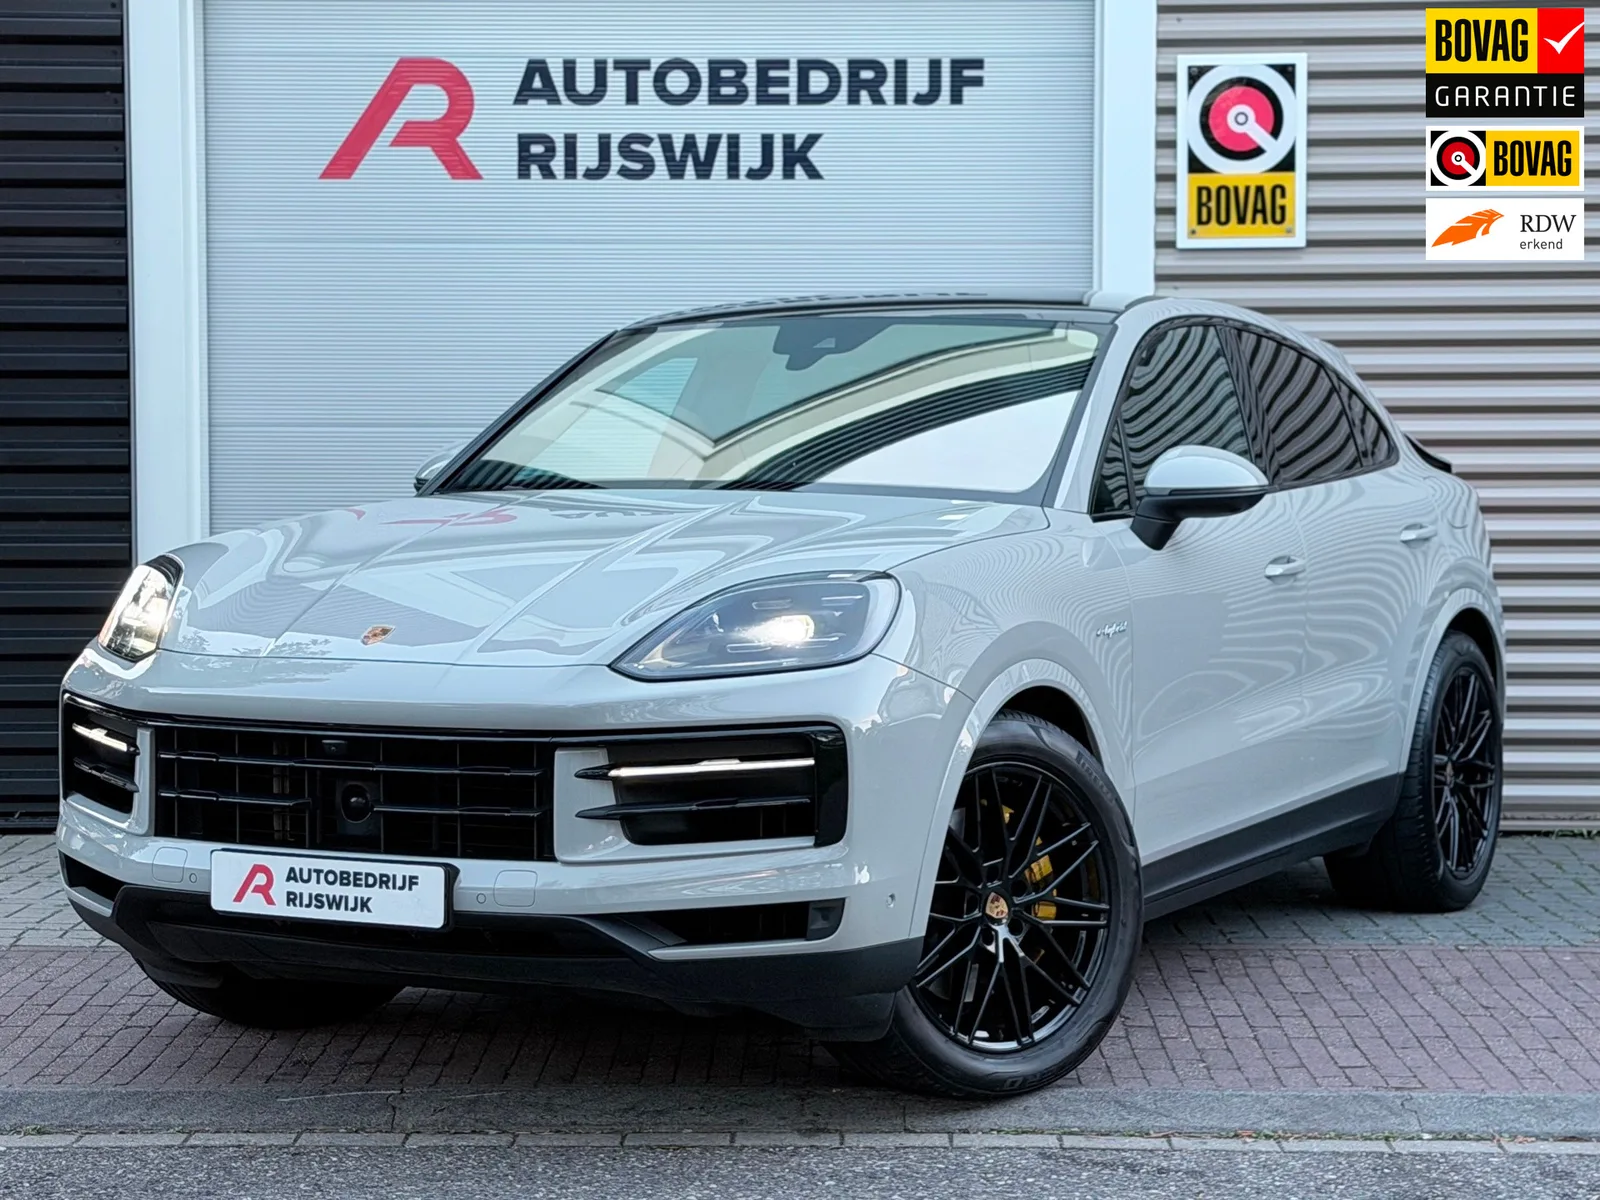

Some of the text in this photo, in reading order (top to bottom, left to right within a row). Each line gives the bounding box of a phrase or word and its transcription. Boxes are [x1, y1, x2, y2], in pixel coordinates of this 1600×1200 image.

[513, 57, 985, 106] AUTOBEDRIJF
[517, 132, 825, 181] RIJSWIJK
[1195, 185, 1287, 226] BOVAG
[285, 867, 420, 892] AUTOBEDRIJF
[285, 891, 373, 914] RIJSWIJK
